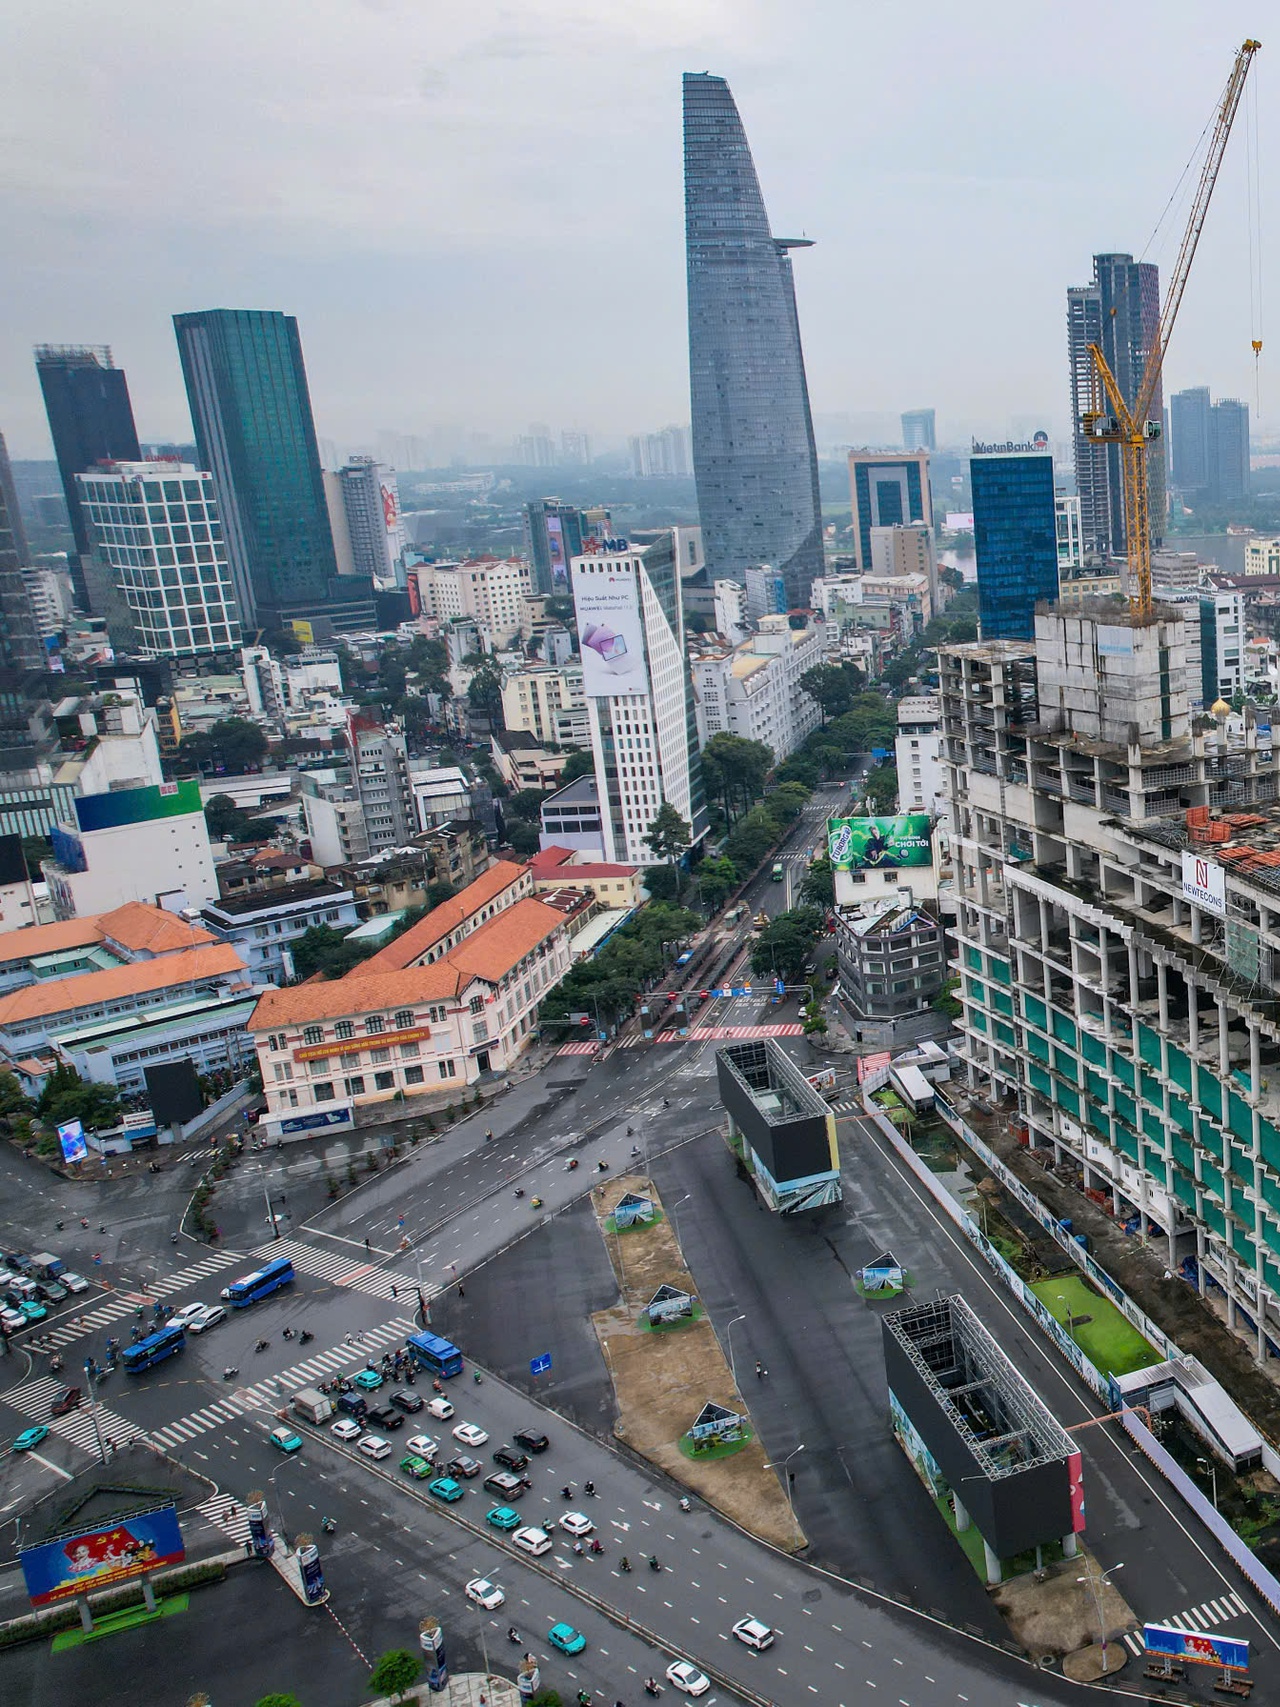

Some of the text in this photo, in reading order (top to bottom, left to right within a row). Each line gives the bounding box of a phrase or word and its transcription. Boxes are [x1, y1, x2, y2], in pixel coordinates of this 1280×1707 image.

[975, 441, 1034, 453] VietinBank
[602, 538, 628, 551] MB
[832, 832, 850, 860] TUBORG
[1183, 882, 1222, 908] NEWTECONS
